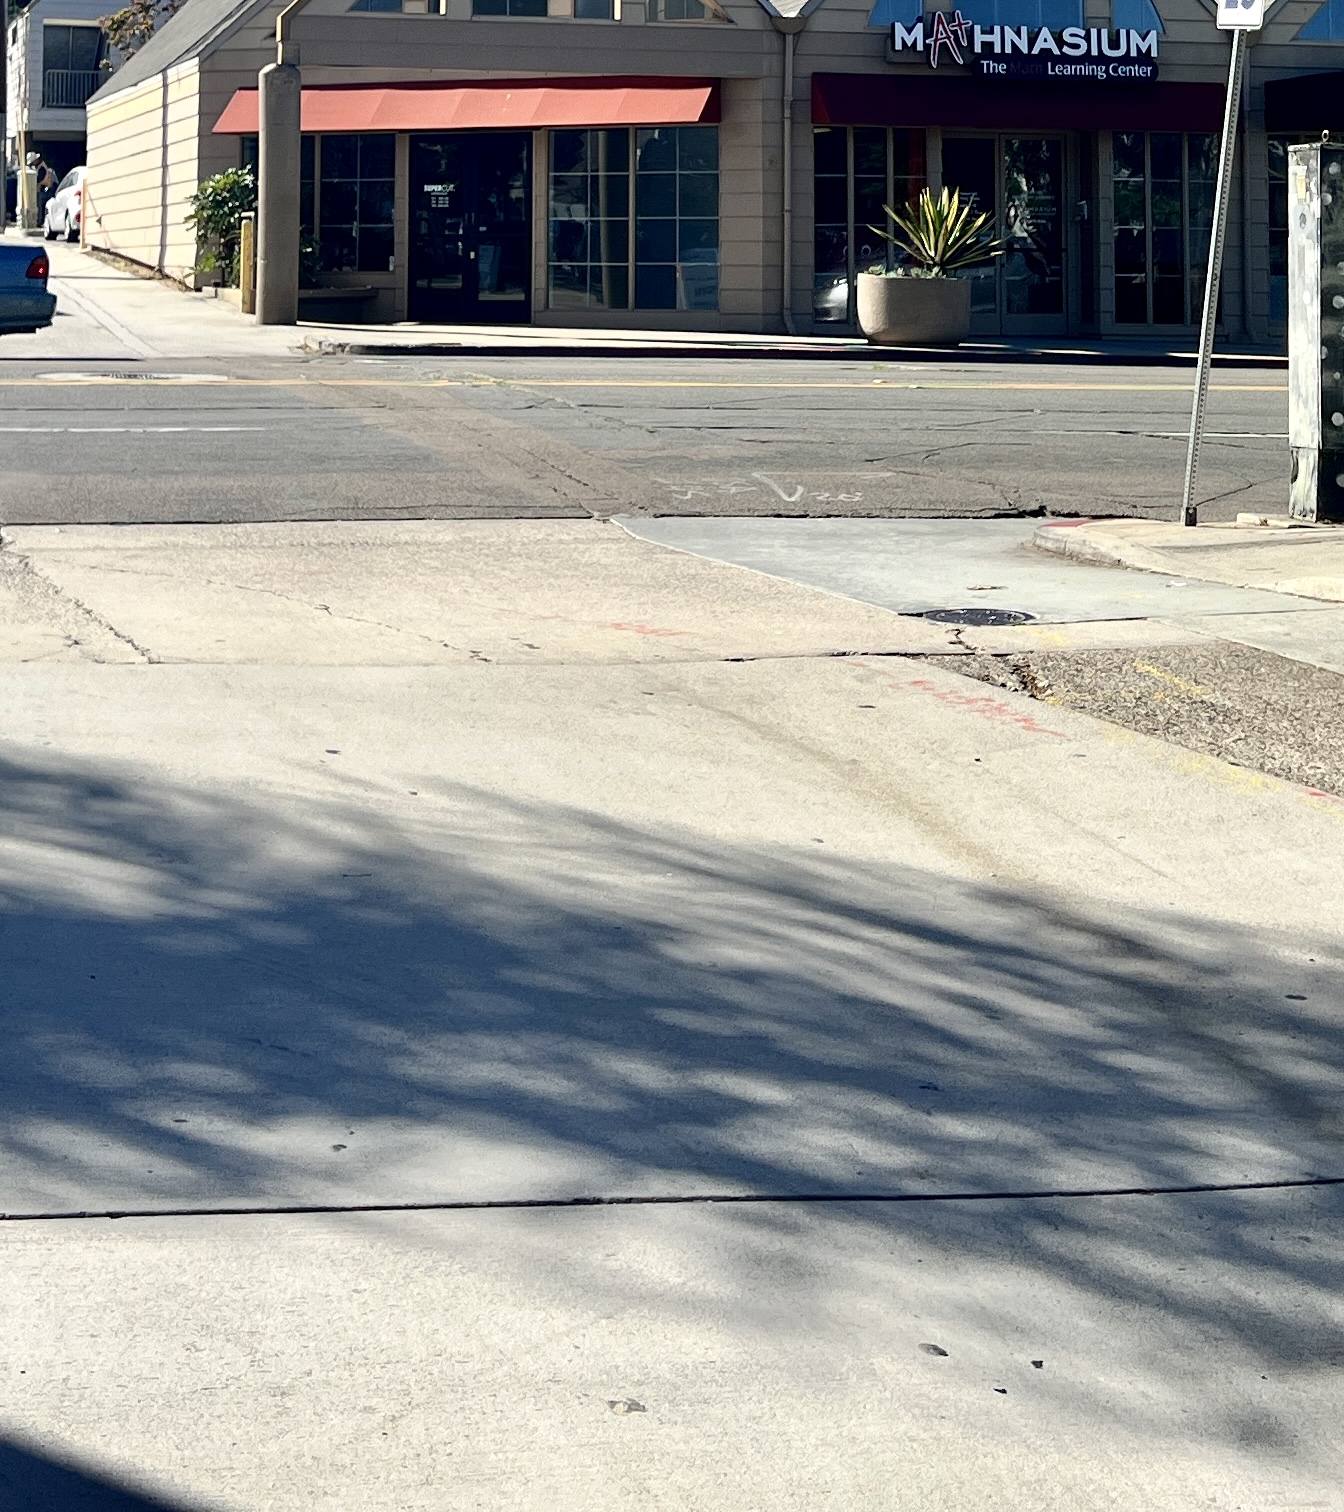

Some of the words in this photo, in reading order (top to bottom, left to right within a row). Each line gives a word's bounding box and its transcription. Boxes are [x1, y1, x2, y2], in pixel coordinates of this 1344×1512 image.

[980, 60, 1007, 74] The
[1048, 62, 1107, 80] Learning
[1109, 62, 1153, 77] Center
